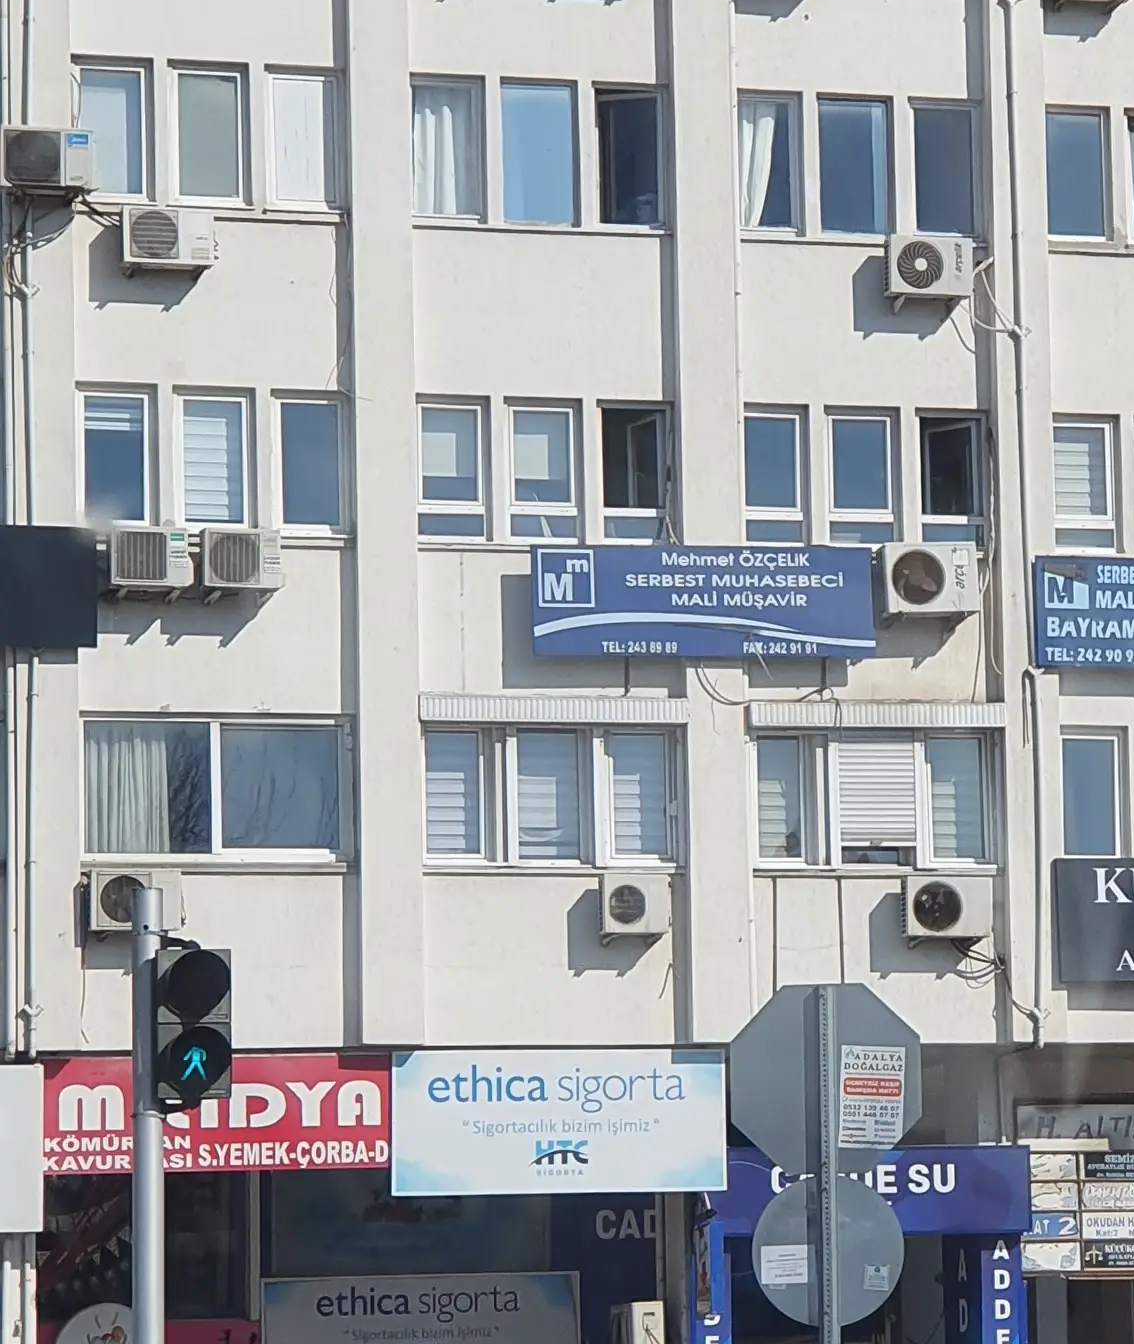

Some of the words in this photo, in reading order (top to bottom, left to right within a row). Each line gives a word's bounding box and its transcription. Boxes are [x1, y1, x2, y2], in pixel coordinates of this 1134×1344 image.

[661, 552, 735, 567] Mehmet
[625, 574, 709, 588] SERBEST
[712, 571, 844, 589] MUHASEBECİ
[671, 591, 719, 608] MALİ
[723, 590, 808, 610] MÜŞAVİR
[601, 641, 626, 654] TEL:
[627, 641, 648, 654] 243
[743, 641, 767, 655] FAX:
[768, 641, 788, 655] 242
[1045, 647, 1075, 662] TEL:
[1077, 647, 1102, 663] 242
[1105, 648, 1123, 664] 90
[854, 1052, 903, 1062] ADALYA
[843, 1062, 904, 1072] DOĞALGAZ
[427, 1064, 549, 1103] ethica
[556, 1067, 687, 1114] sigorta
[561, 1119, 602, 1134] bizim
[44, 1134, 191, 1154] KÖMÜRAN
[532, 1140, 589, 1165] HTC
[908, 1163, 956, 1194] SU
[1058, 1216, 1077, 1236] 2
[1086, 1217, 1125, 1228] OKUDAN
[316, 1286, 409, 1317] ethica
[418, 1286, 521, 1323] sigorta
[421, 1327, 455, 1340] bizim
